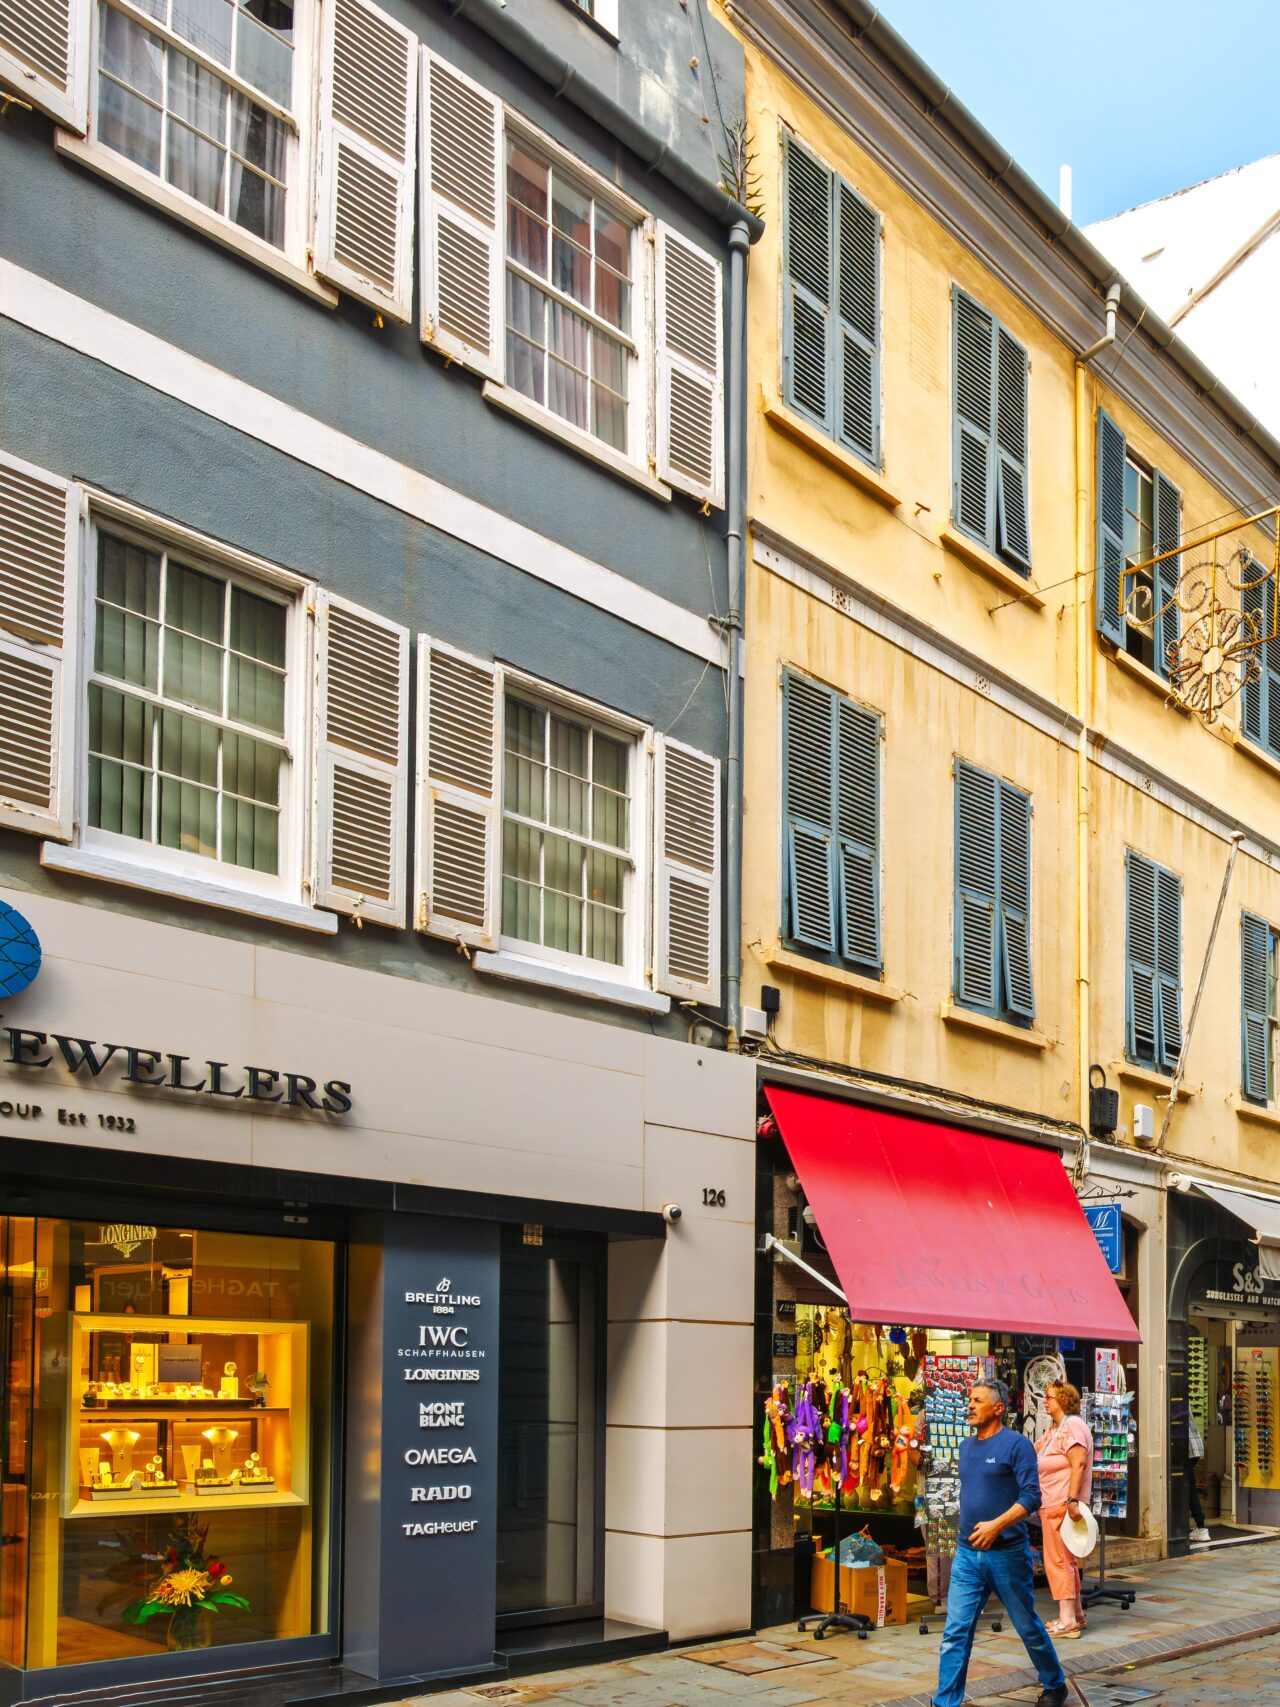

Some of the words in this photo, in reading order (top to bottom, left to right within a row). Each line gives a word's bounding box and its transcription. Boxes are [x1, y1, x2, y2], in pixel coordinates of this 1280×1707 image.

[3, 1027, 352, 1114] EWELLERS
[57, 1108, 87, 1126] Est
[97, 1113, 136, 1133] 1932
[702, 1187, 726, 1207] 126
[1232, 1262, 1265, 1294] S&S
[405, 1292, 481, 1306] BREITLING
[1206, 1289, 1244, 1303] SUNGLASSES
[1247, 1295, 1260, 1304] AND
[433, 1305, 454, 1314] 1884
[418, 1325, 468, 1347] IWC
[397, 1349, 485, 1358] SCHAFFHAUSEN
[404, 1369, 480, 1381] LONGINES
[419, 1402, 465, 1415] MONT
[419, 1415, 465, 1427] BLANC
[404, 1446, 478, 1465] OMEGA
[410, 1485, 472, 1502] RADO
[402, 1520, 479, 1536] TAGHeuer
